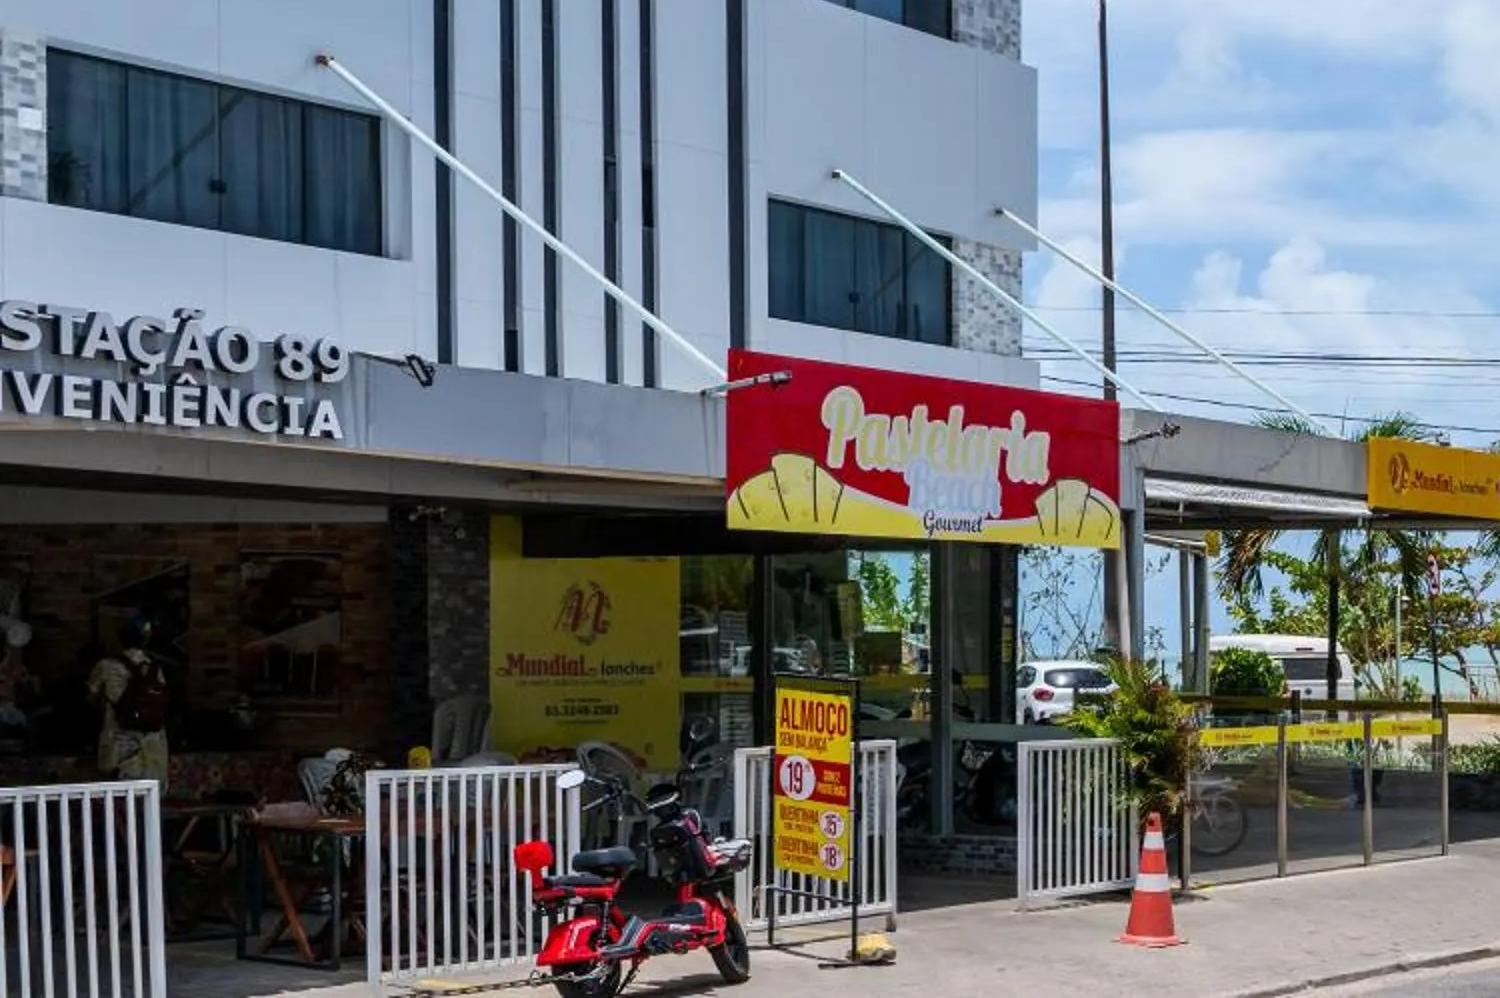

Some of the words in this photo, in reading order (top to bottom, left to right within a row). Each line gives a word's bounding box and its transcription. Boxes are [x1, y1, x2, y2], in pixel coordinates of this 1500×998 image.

[278, 332, 350, 383] 89
[0, 369, 343, 439] VENIÊNCIA
[821, 386, 1051, 484] Pastelaria
[922, 508, 983, 538] Gourmet
[496, 652, 597, 677] Mundial
[601, 660, 656, 677] lanches
[779, 696, 849, 741] ALMOÇO
[787, 760, 804, 795] 19
